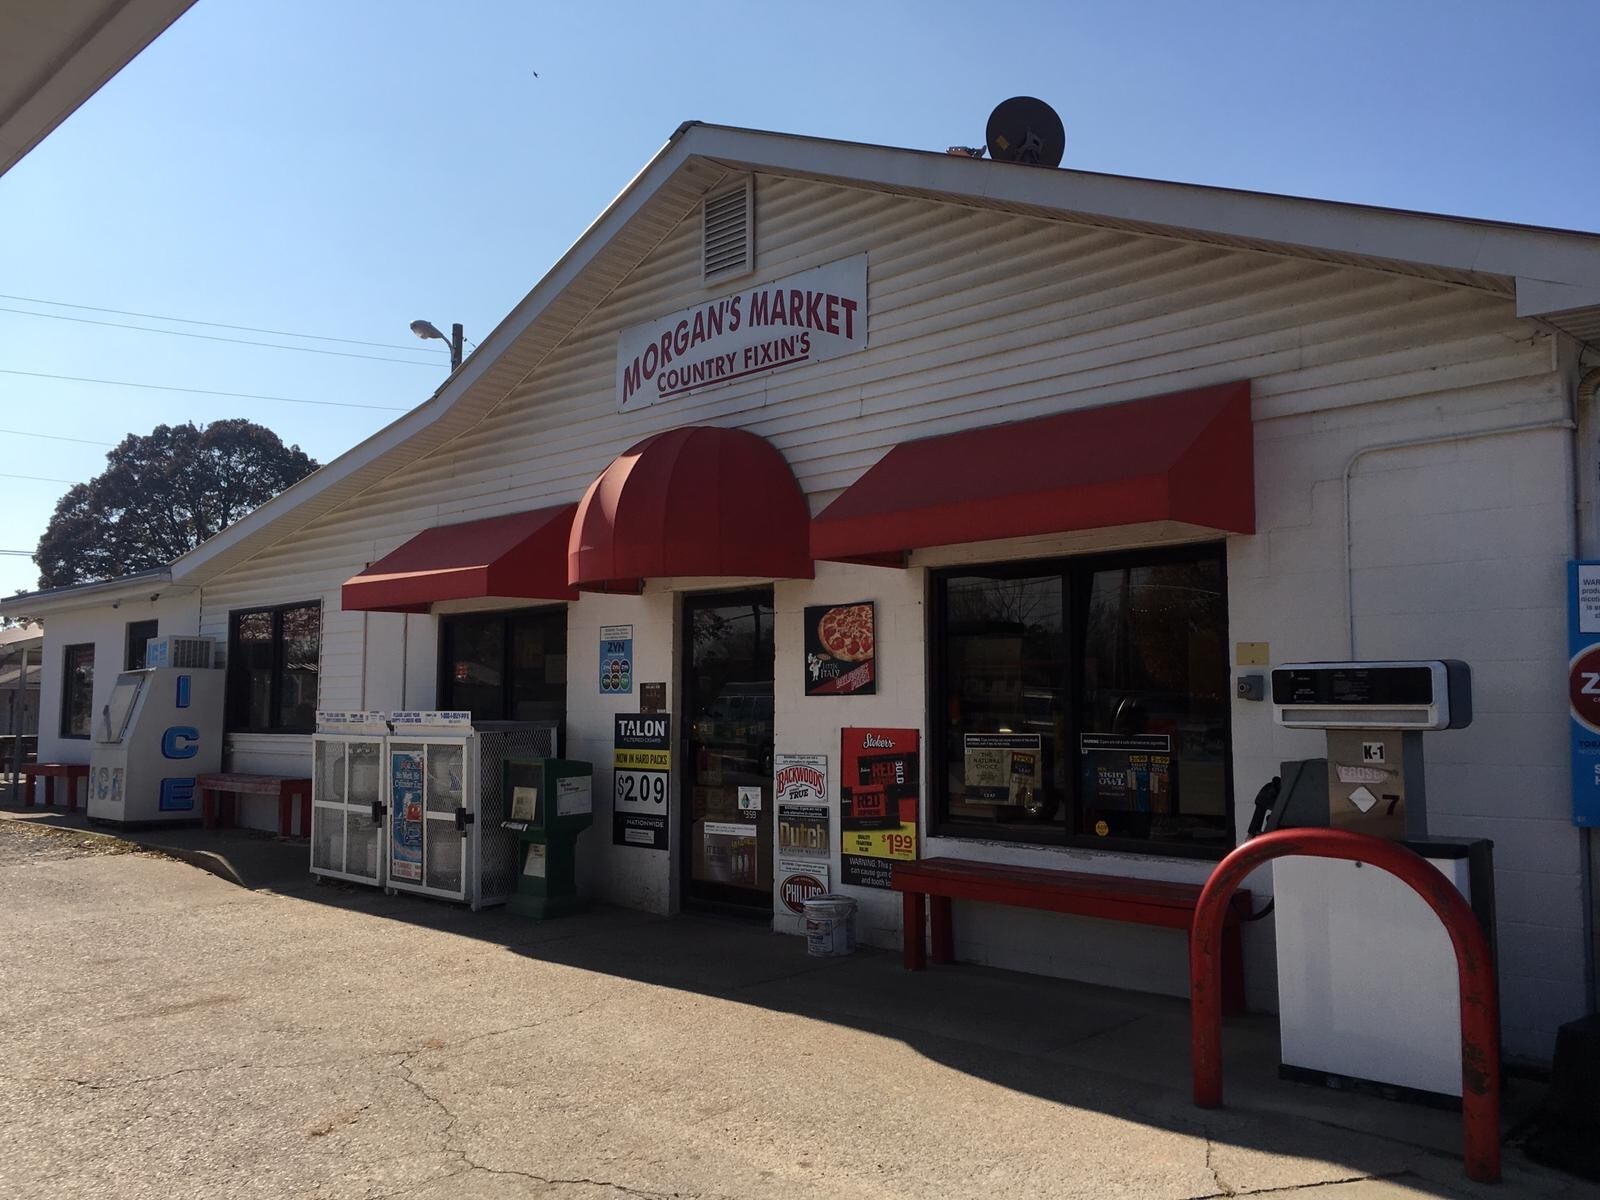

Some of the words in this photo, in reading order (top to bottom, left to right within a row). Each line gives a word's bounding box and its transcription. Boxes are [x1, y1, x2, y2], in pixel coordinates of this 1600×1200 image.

[622, 296, 741, 404] MORGAN'S
[748, 289, 857, 340] MARKET
[656, 351, 737, 392] COUNTRY
[743, 331, 811, 369] FIXIN'S
[607, 641, 625, 653] ZYN
[618, 720, 665, 737] TALON
[159, 675, 199, 811] ICE
[1363, 745, 1384, 760] K-1
[616, 752, 629, 764] NOW
[629, 752, 635, 764] IN
[635, 753, 650, 764] HARD
[650, 754, 667, 765] PACKS
[777, 767, 824, 796] BACKWOODS
[895, 760, 905, 784] BOLD
[1098, 778, 1125, 786] OWL
[89, 767, 124, 801] ICE
[617, 774, 664, 804] $2.09
[789, 789, 809, 800] TRUE
[857, 793, 881, 808] RED
[1382, 794, 1400, 816] 7
[780, 822, 826, 848] Dutch
